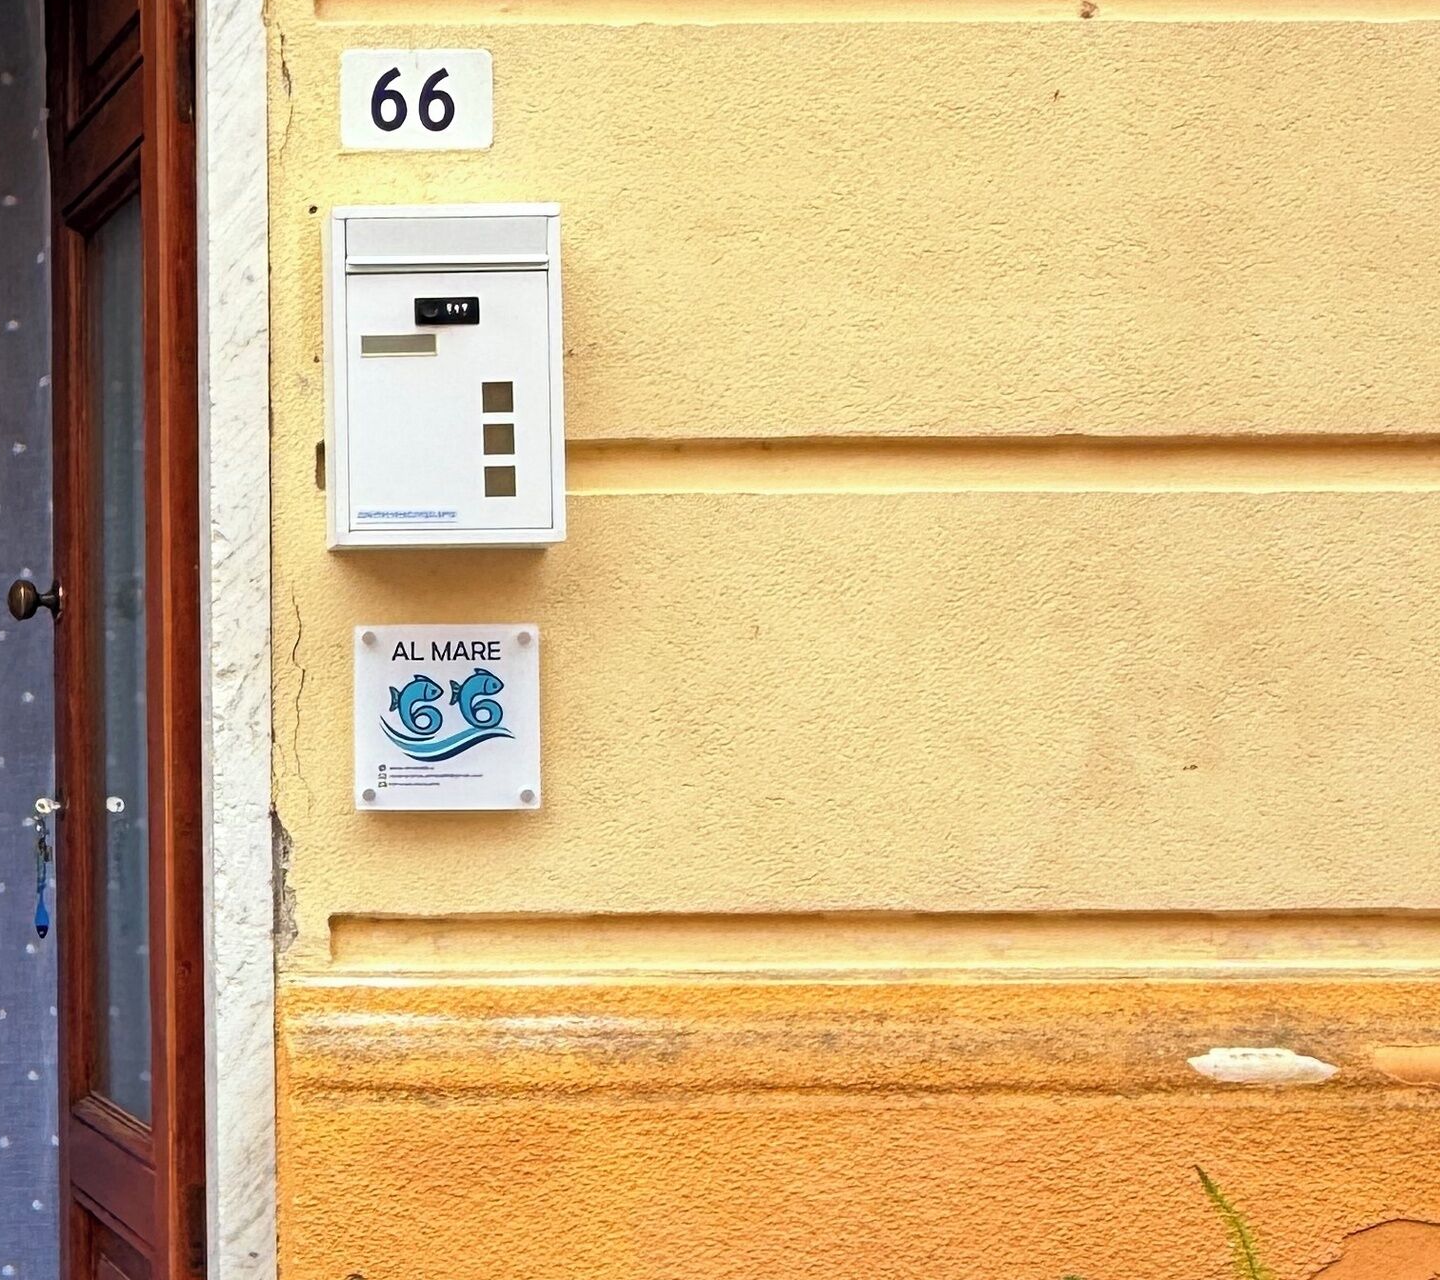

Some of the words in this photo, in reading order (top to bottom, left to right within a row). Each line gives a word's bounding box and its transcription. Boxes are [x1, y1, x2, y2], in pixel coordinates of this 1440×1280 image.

[370, 66, 456, 132] 66
[391, 641, 425, 662] AL
[431, 641, 502, 662] MARE
